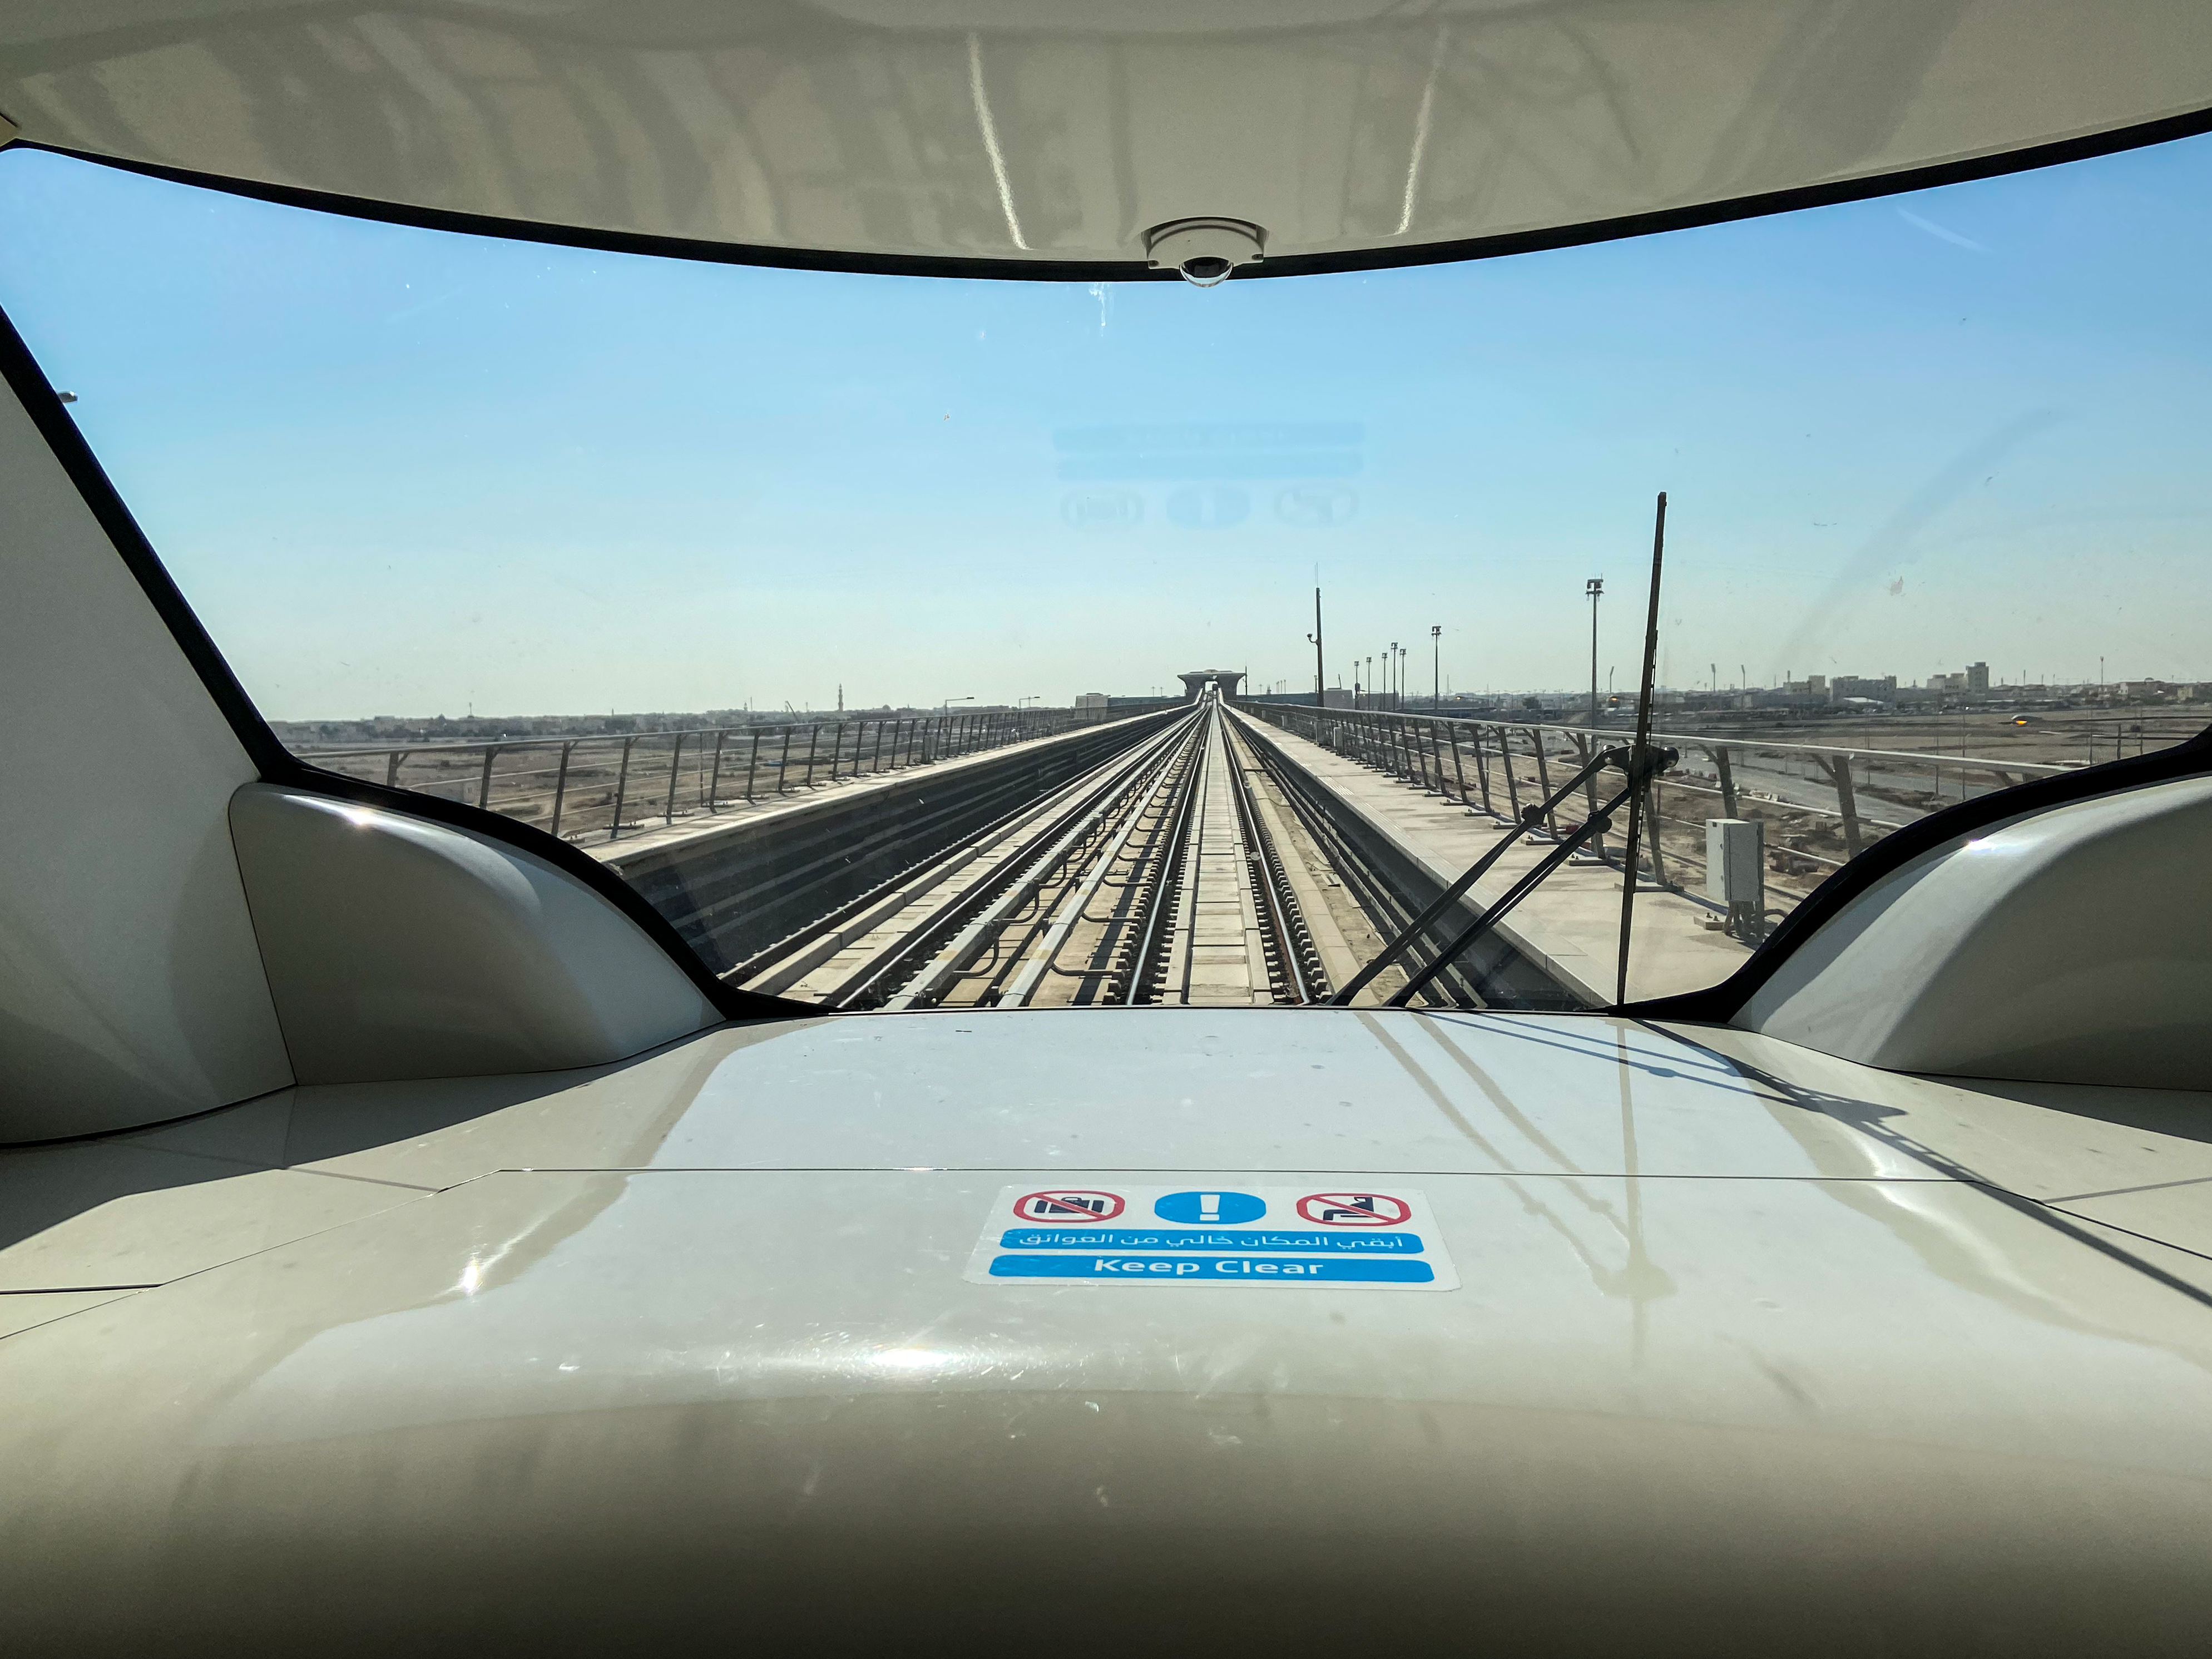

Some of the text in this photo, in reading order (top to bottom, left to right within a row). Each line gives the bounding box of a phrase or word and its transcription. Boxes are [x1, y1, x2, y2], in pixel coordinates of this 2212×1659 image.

[1019, 1234, 1114, 1245] العوائق
[1120, 1235, 1159, 1245] من
[1166, 1235, 1234, 1247] خالي
[1241, 1235, 1329, 1246] المكان
[1094, 1259, 1324, 1275] Keep Clear
